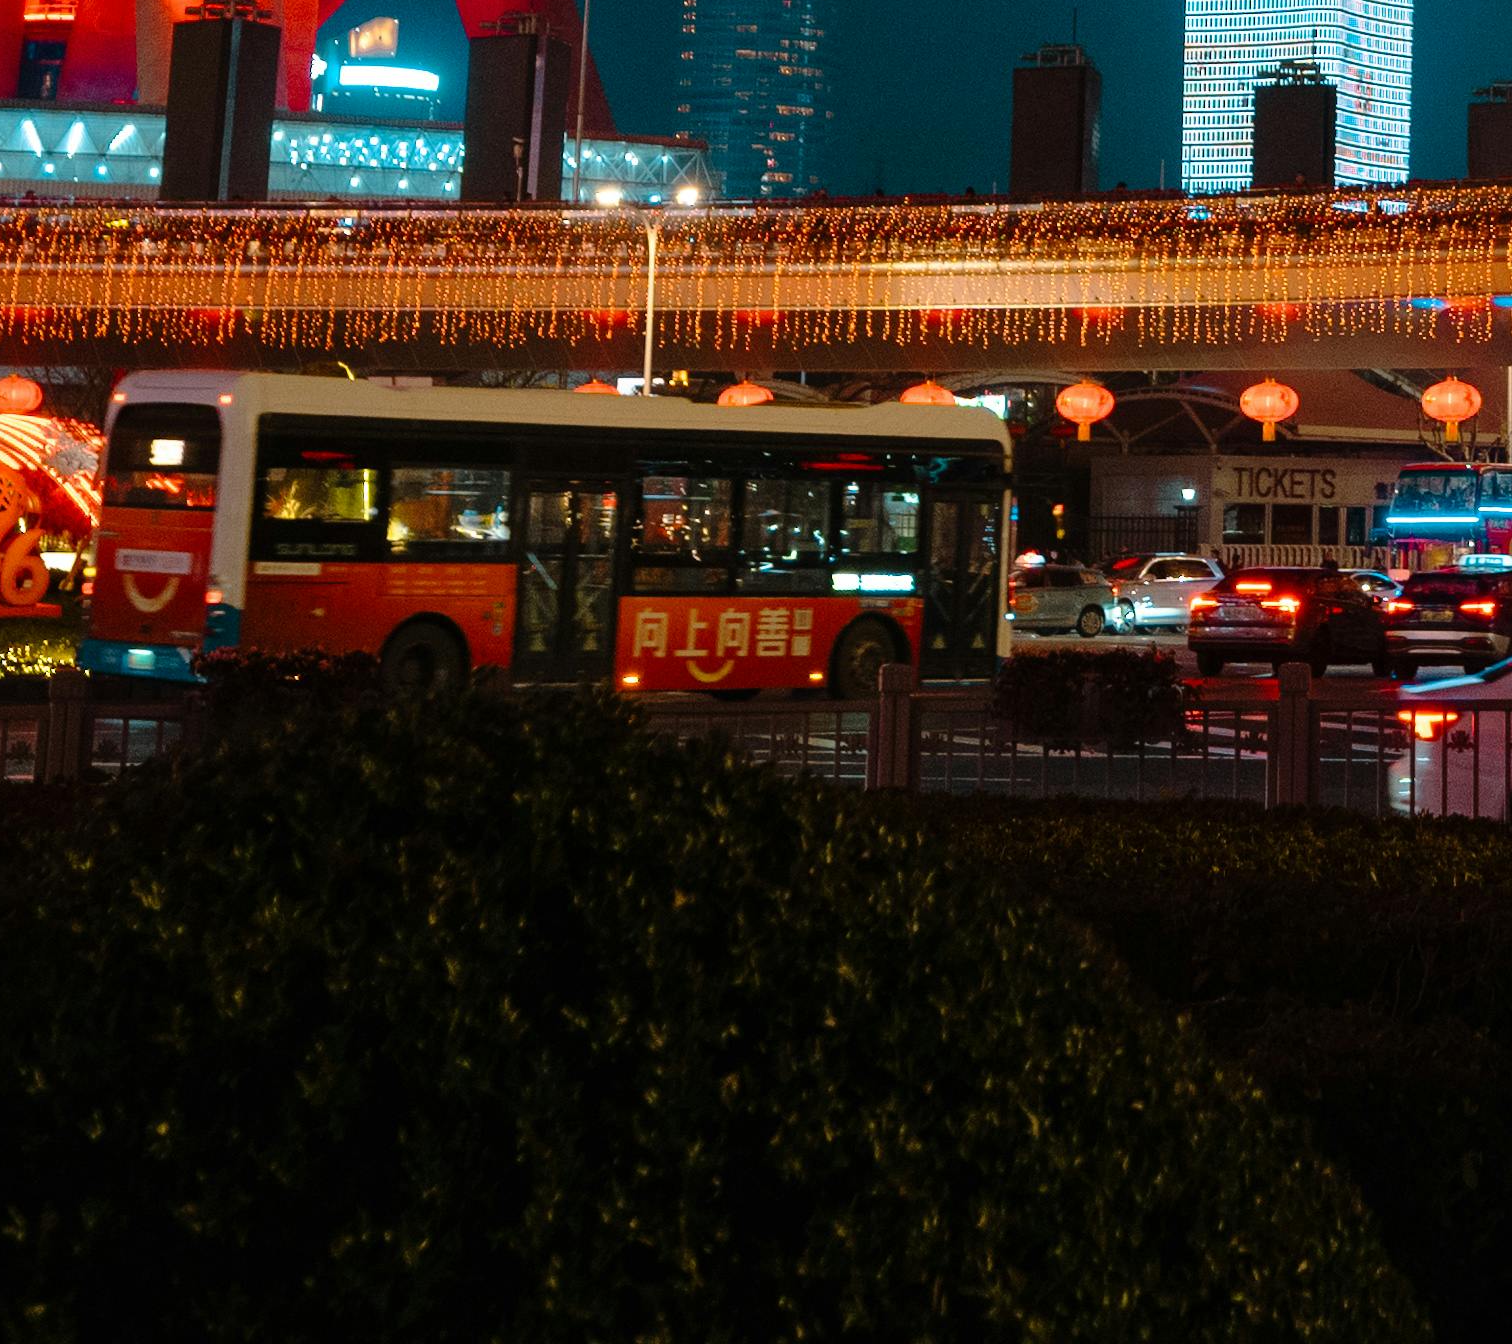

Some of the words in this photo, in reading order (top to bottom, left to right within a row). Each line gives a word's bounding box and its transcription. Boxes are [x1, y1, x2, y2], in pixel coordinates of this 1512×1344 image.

[1233, 467, 1337, 500] TICKETS
[633, 608, 791, 658] 向上向善
